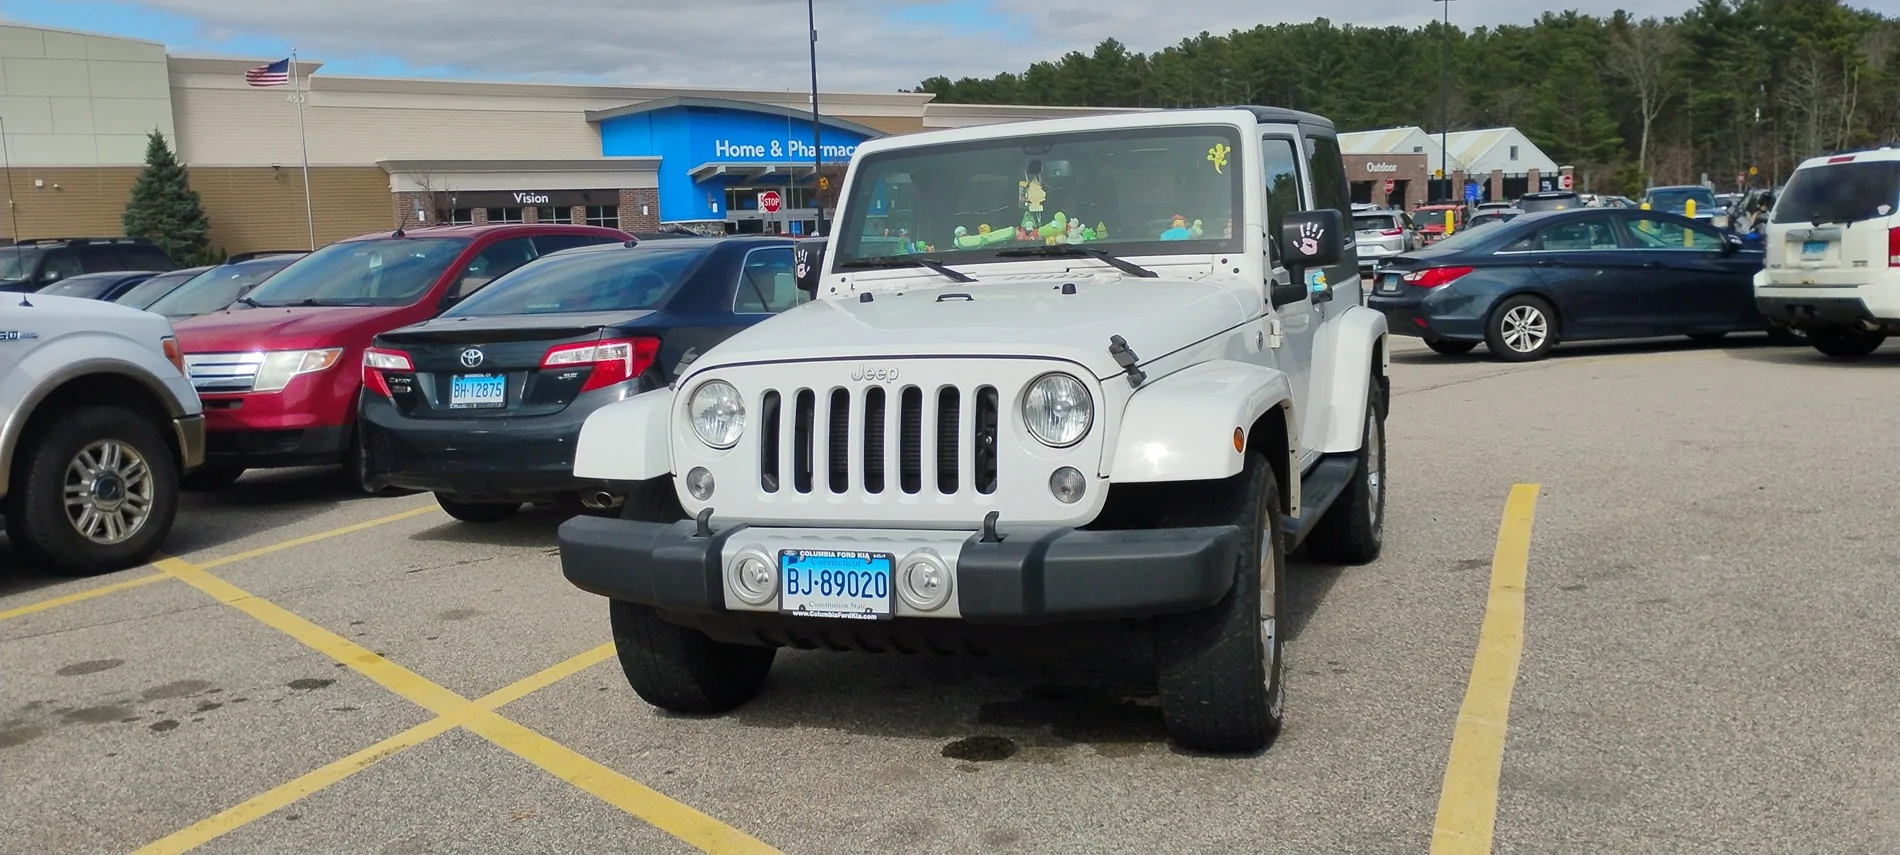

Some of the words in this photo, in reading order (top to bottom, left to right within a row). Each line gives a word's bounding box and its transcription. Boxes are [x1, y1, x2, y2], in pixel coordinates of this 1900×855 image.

[715, 140, 765, 158] Home
[770, 140, 783, 158] &
[788, 140, 857, 158] Phamac
[1366, 162, 1398, 172] Outdoor
[513, 192, 549, 204] Vision
[763, 197, 780, 207] STOP
[851, 363, 900, 383] Jeep
[799, 550, 837, 558] COLUMBIA
[837, 551, 856, 559] FORD
[857, 552, 871, 560] KIA
[811, 558, 861, 567] Connecticut
[808, 600, 849, 609] Constitution
[850, 601, 867, 610] State
[792, 610, 878, 620] www.ColumbiaFordKia.com
